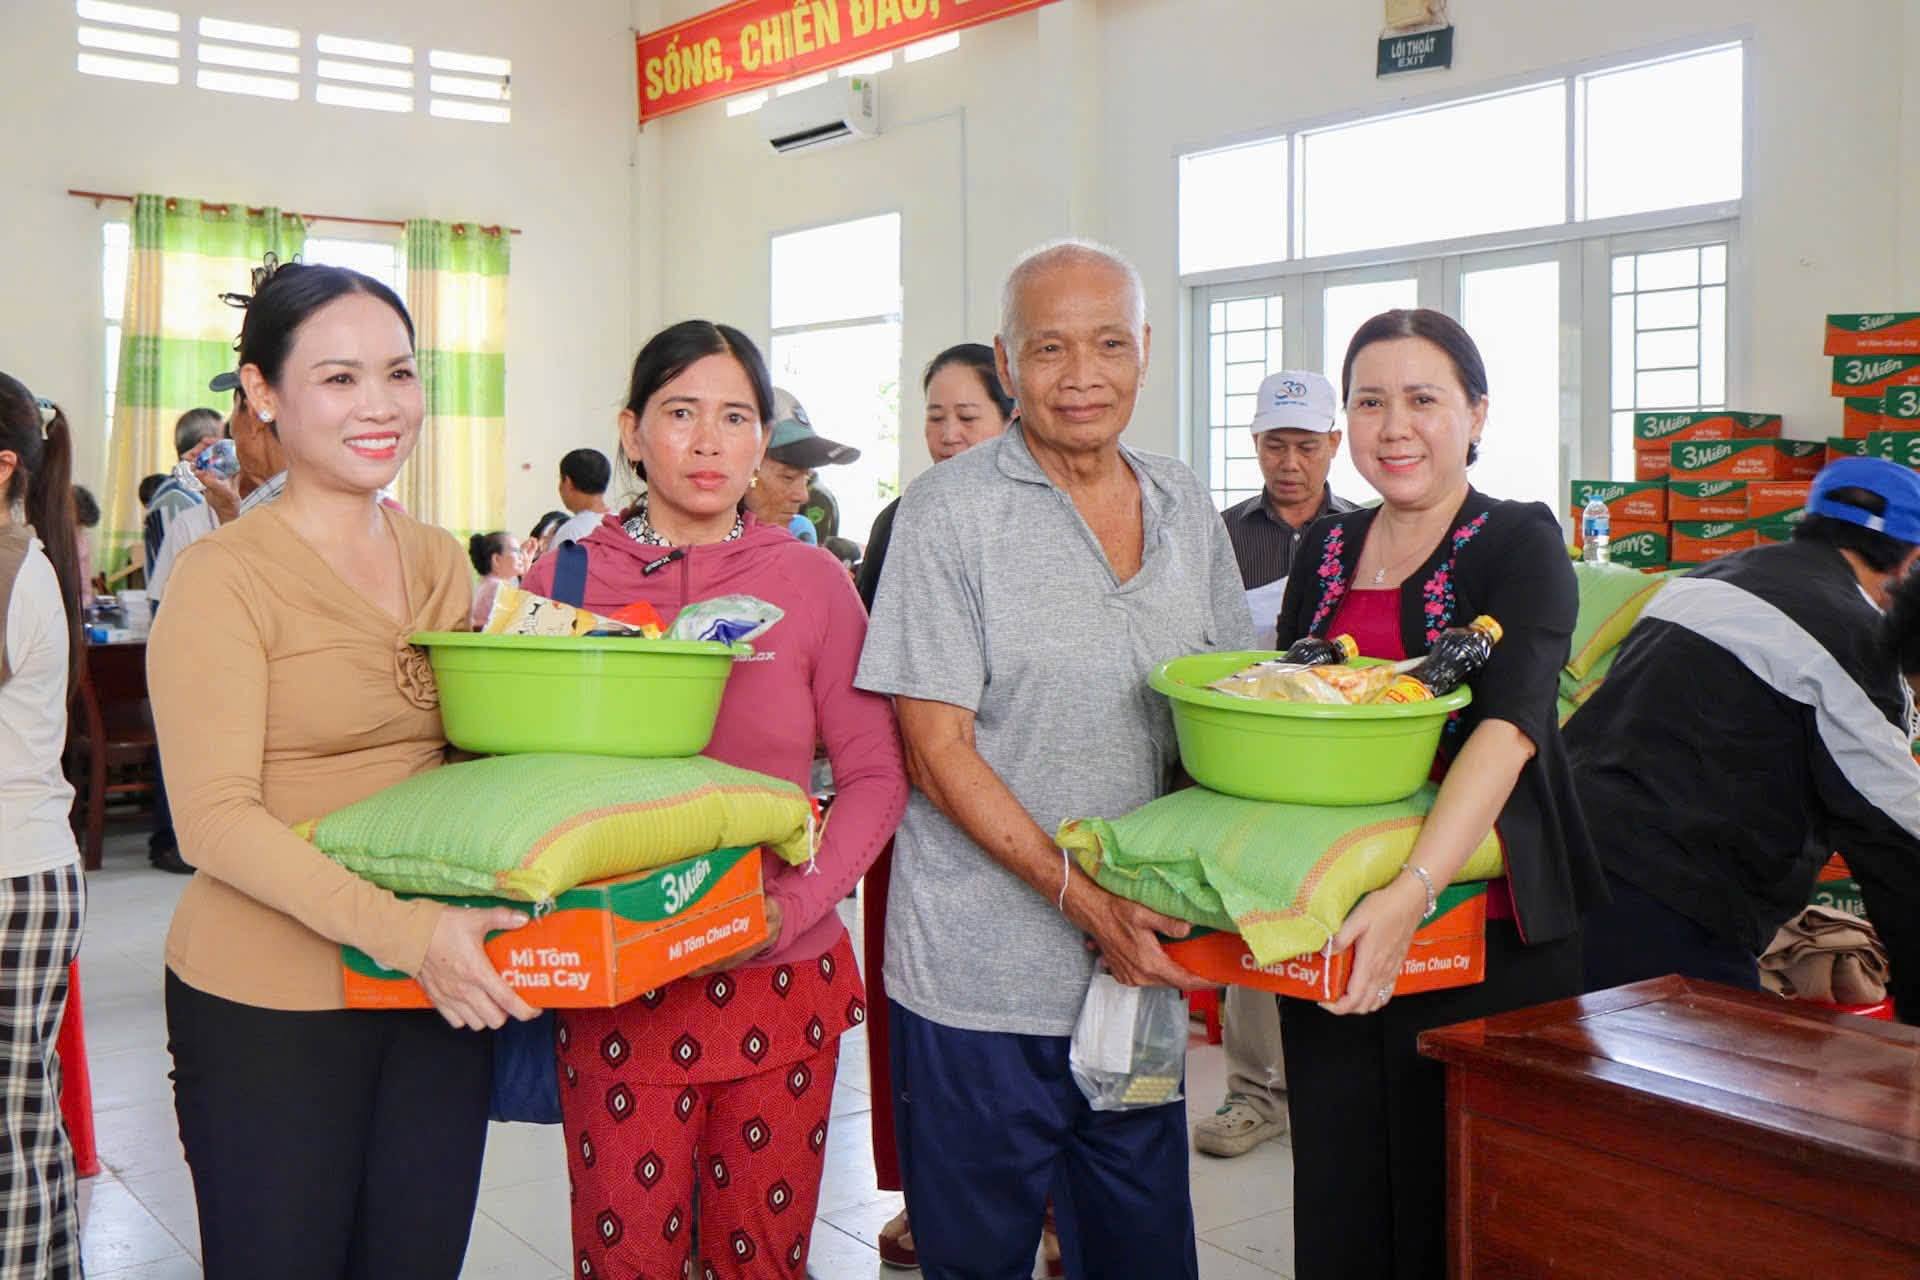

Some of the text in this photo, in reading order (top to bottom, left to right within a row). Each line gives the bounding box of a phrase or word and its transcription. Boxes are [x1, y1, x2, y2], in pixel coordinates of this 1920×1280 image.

[645, 33, 734, 100] SỐNG,
[1398, 55, 1425, 67] EXIT
[706, 924, 732, 945] Chua
[732, 915, 751, 933] Cay
[1287, 962, 1320, 986] Cay
[1428, 955, 1453, 972] Chua
[1454, 955, 1471, 970] Cay
[501, 968, 591, 991] Chua Cay
